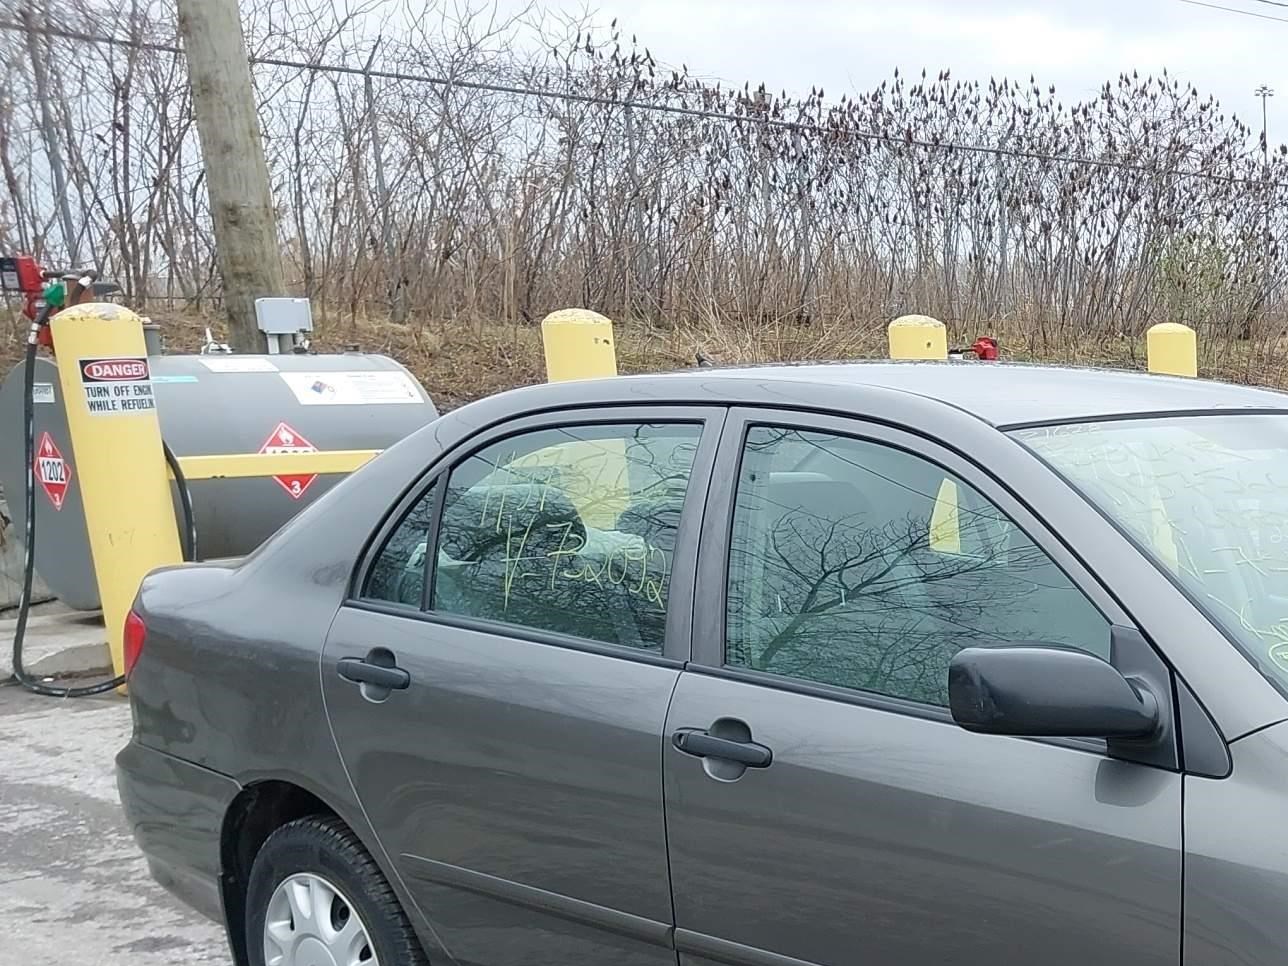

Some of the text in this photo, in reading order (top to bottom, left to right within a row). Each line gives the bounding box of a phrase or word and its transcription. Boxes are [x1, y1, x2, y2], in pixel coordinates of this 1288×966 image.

[91, 363, 145, 377] DANGER
[84, 386, 110, 398] TURN
[114, 385, 130, 397] OFF
[87, 399, 116, 411] WHILE
[42, 461, 65, 482] 1202
[290, 480, 301, 494] 3
